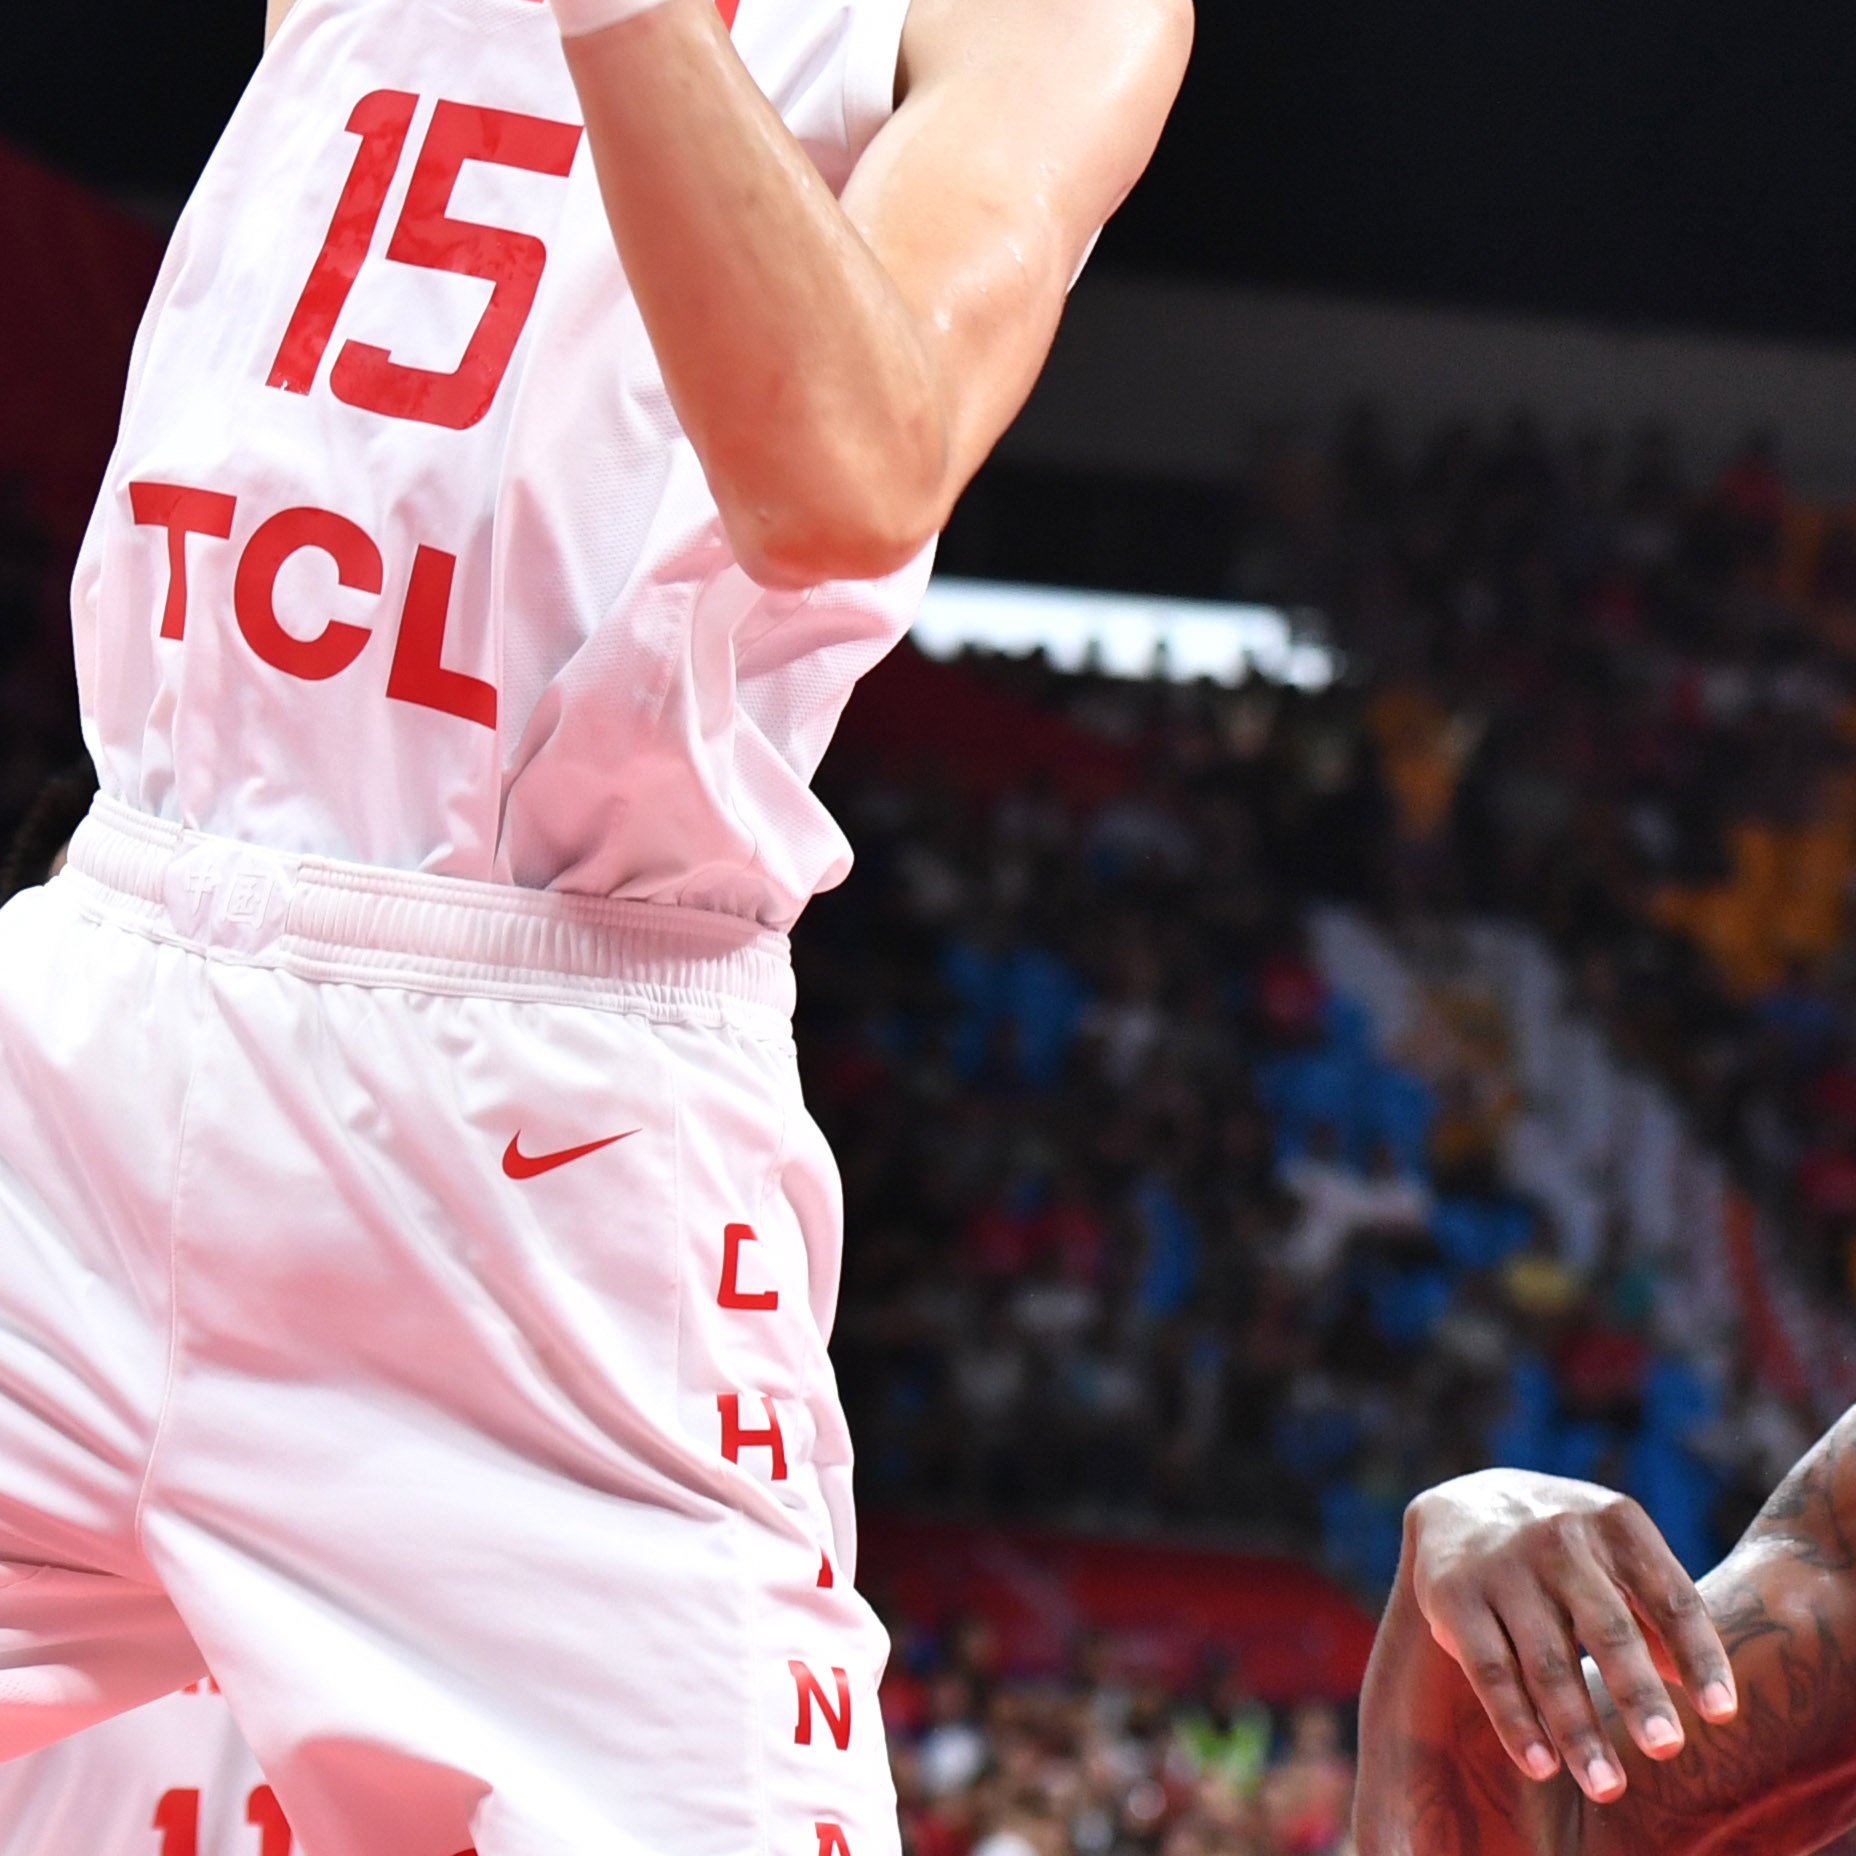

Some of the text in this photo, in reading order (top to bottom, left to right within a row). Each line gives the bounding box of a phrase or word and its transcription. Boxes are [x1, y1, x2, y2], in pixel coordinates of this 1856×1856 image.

[264, 89, 584, 430] 15
[129, 481, 497, 731] TCL
[185, 862, 276, 931] 中国
